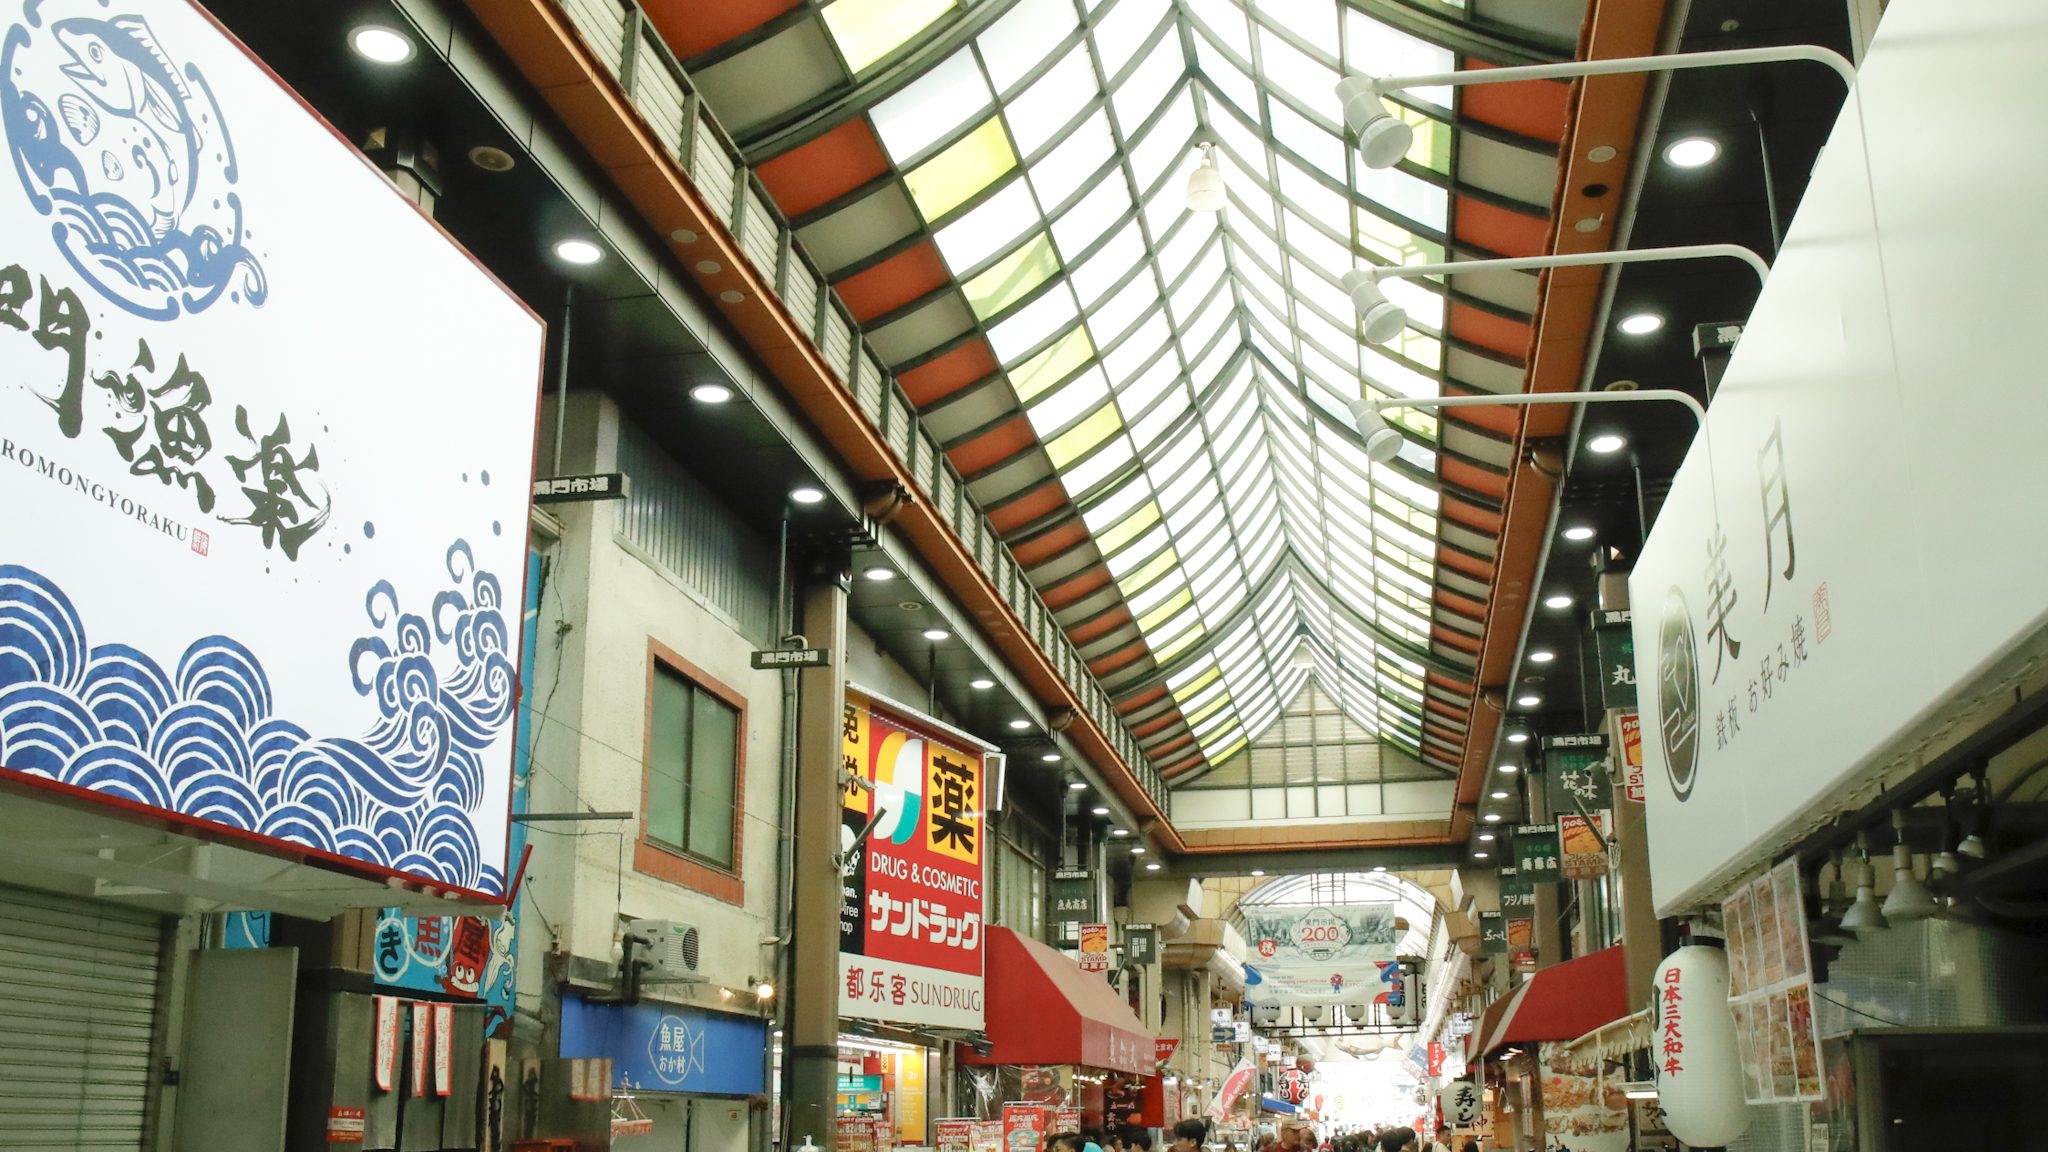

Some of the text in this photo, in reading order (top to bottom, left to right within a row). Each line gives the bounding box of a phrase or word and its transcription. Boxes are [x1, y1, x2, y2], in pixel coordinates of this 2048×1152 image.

[1, 438, 188, 543] ROMONGYORAKU
[533, 476, 609, 496] 黒門市場
[760, 650, 819, 663] 黒門市場
[1715, 614, 1808, 751] 鉄板 お好み焼
[1552, 736, 1602, 747] 黒門市場
[1560, 769, 1598, 800] 花の木
[931, 754, 975, 855] 薬
[1517, 825, 1557, 834] 黒門市場
[1563, 819, 1587, 828] クロモ
[871, 851, 979, 899] DRUG & COSMETIC
[1055, 871, 1088, 879] 黒門市場
[869, 889, 981, 950] サンドラッグ
[1301, 926, 1339, 942] 200
[846, 965, 907, 1006] 都乐客
[911, 981, 981, 1012] SUNDRUG
[659, 1022, 686, 1053] 魚屋
[1662, 967, 1684, 1078] 日本三大和牛
[659, 1055, 687, 1075] おか村
[1454, 1086, 1476, 1122] 寿し
